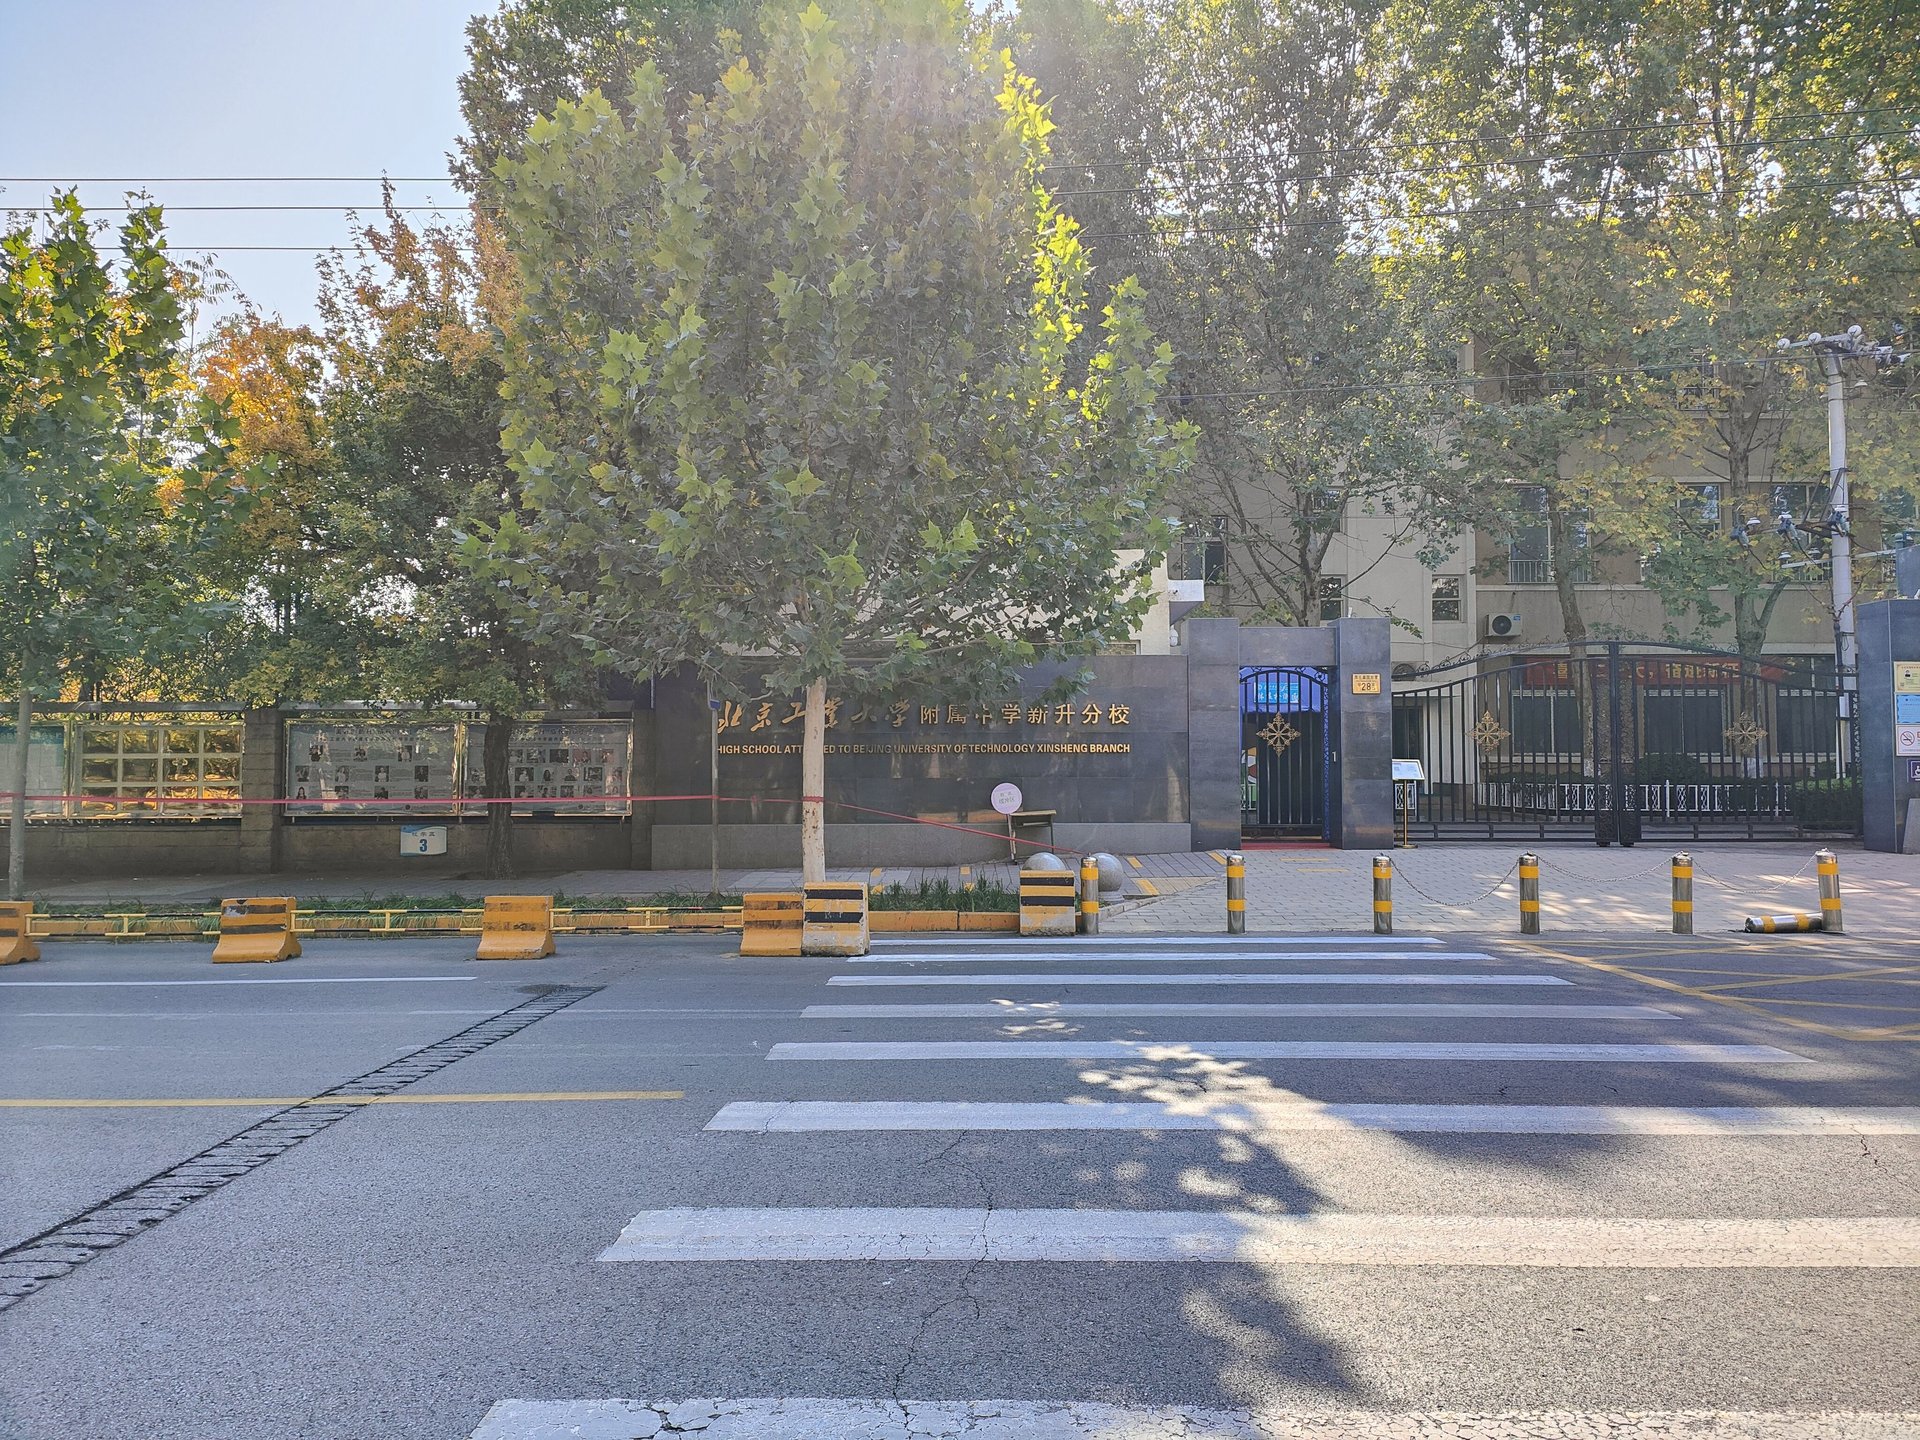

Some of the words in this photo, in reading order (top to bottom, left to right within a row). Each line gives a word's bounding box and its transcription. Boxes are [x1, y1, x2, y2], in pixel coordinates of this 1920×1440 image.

[742, 744, 782, 754] SCHOOL
[784, 744, 835, 754] ATTED
[838, 744, 851, 754] TO
[853, 744, 892, 754] BEIJING
[893, 744, 952, 754] UNIVERSITY
[953, 744, 967, 754] OF
[969, 744, 1035, 754] TECHNOLOGY
[1036, 744, 1088, 754] XINSHENG
[1089, 744, 1131, 754] BRANCH
[419, 838, 428, 852] 3
